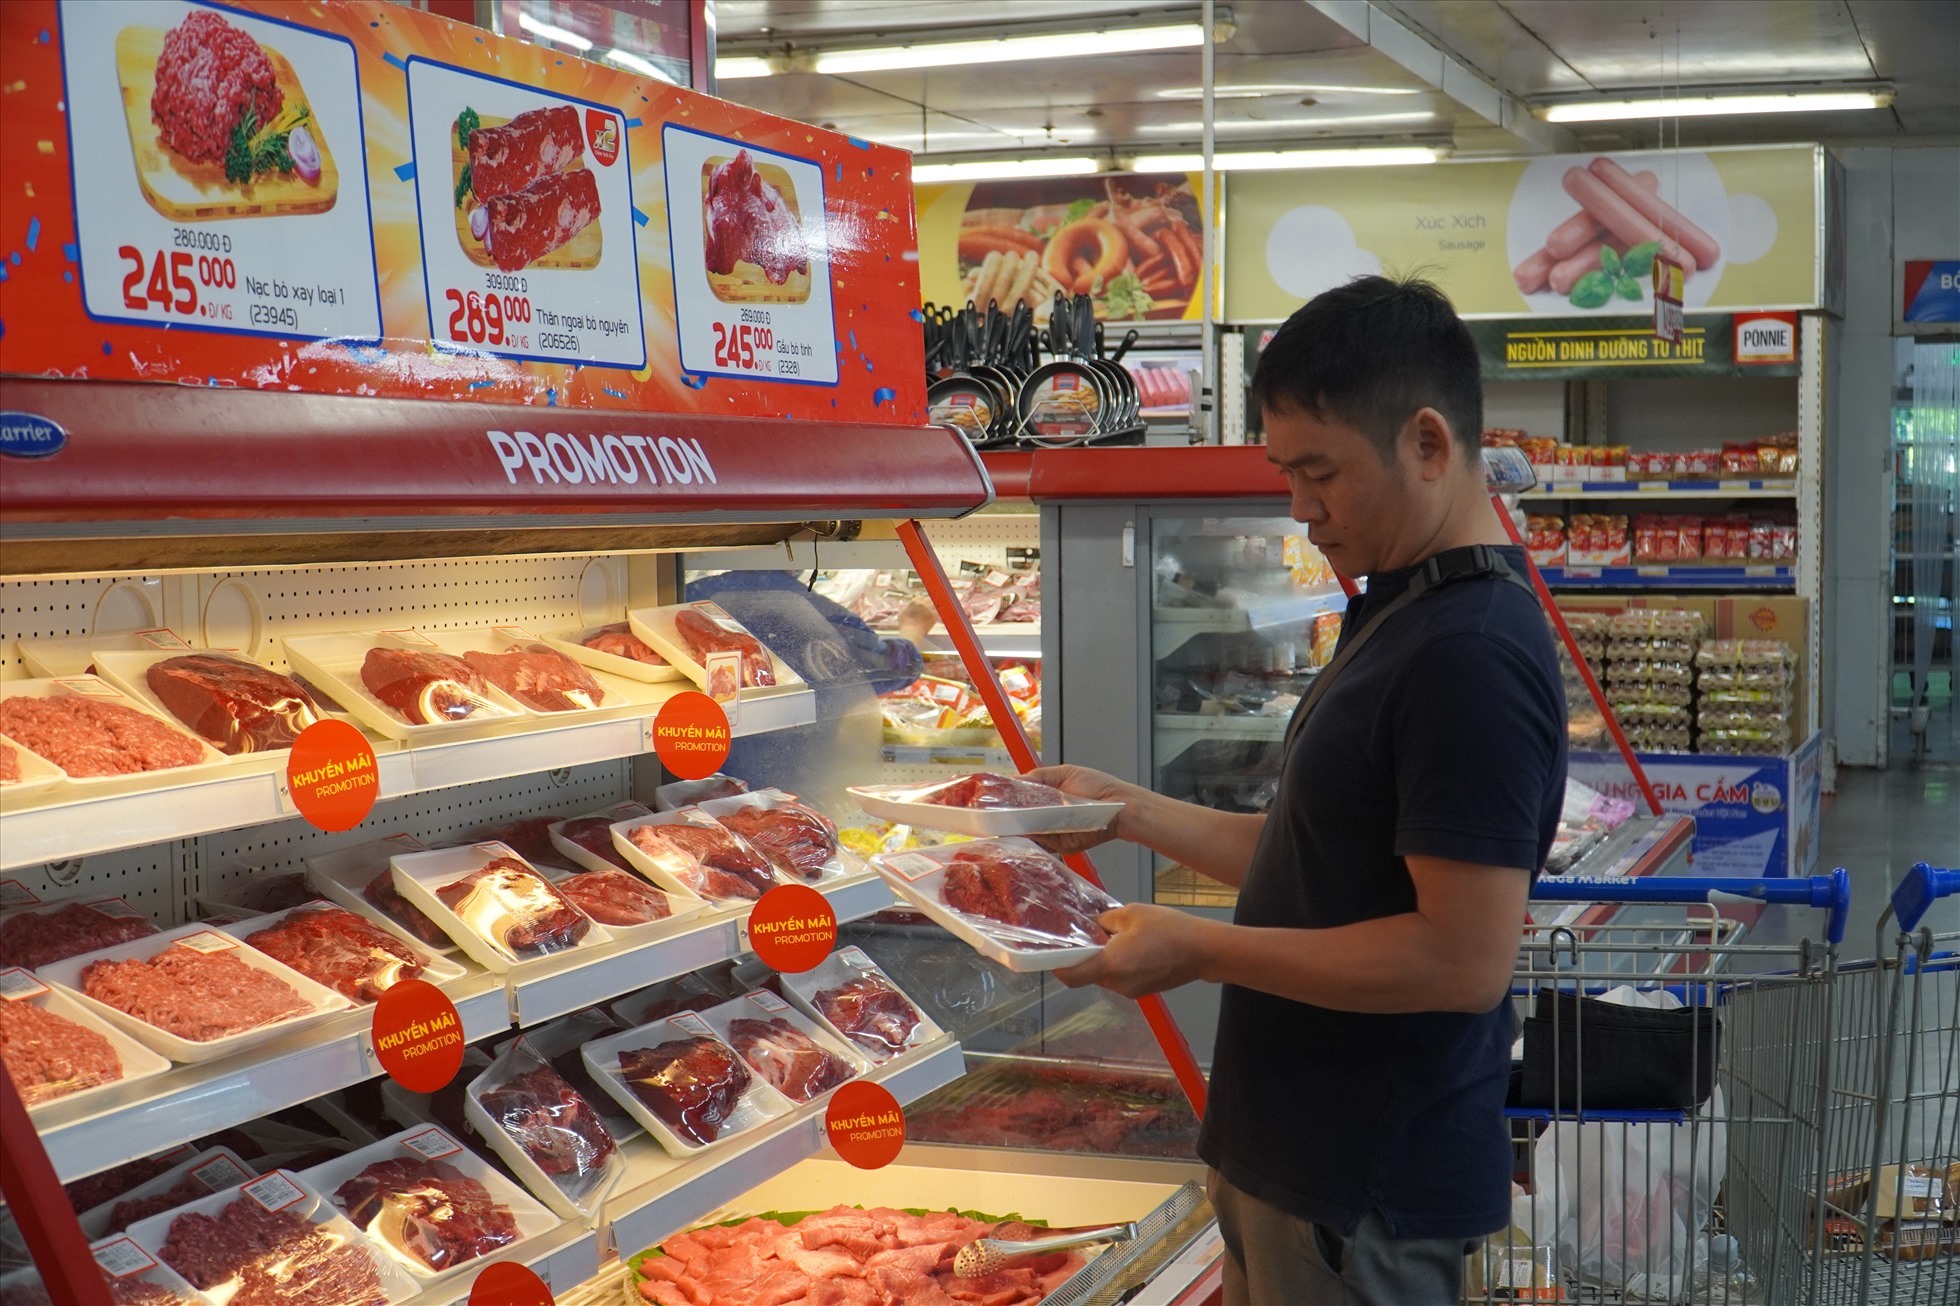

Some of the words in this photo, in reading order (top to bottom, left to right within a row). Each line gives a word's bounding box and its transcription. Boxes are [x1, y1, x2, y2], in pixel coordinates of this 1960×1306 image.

[174, 228, 220, 251] 280.000
[1438, 239, 1487, 253] Sausage
[246, 276, 270, 299] Nạc
[273, 279, 288, 299] bò
[292, 286, 313, 307] xay
[318, 284, 337, 307] loại
[340, 288, 345, 305] 1
[249, 304, 298, 330] (23945)
[538, 332, 580, 354] (206526)
[1507, 336, 1556, 361] NGUỒN
[1560, 340, 1595, 361] DINH
[778, 360, 800, 377] (2328)
[0, 422, 53, 442] arrier
[486, 430, 717, 484] PROMOTION
[658, 722, 703, 739] KHUYẾN
[705, 726, 726, 739] MÃI
[675, 741, 726, 752] PROMOTION
[293, 758, 344, 788] KHUYẾN
[346, 753, 372, 772] MÃI
[316, 773, 375, 798] PROMOTION
[1653, 783, 1688, 801] GIA
[753, 915, 805, 934] KHUYẾN
[808, 914, 831, 929] MÃI
[774, 931, 833, 945] PROMOTION
[378, 1020, 429, 1051] KHUYẾN
[430, 1011, 456, 1032] MÃI
[402, 1031, 461, 1060] PROMOTION
[831, 1112, 875, 1131] KHUYẾN
[878, 1110, 899, 1125] MÃI
[850, 1127, 902, 1142] PROMOTION
